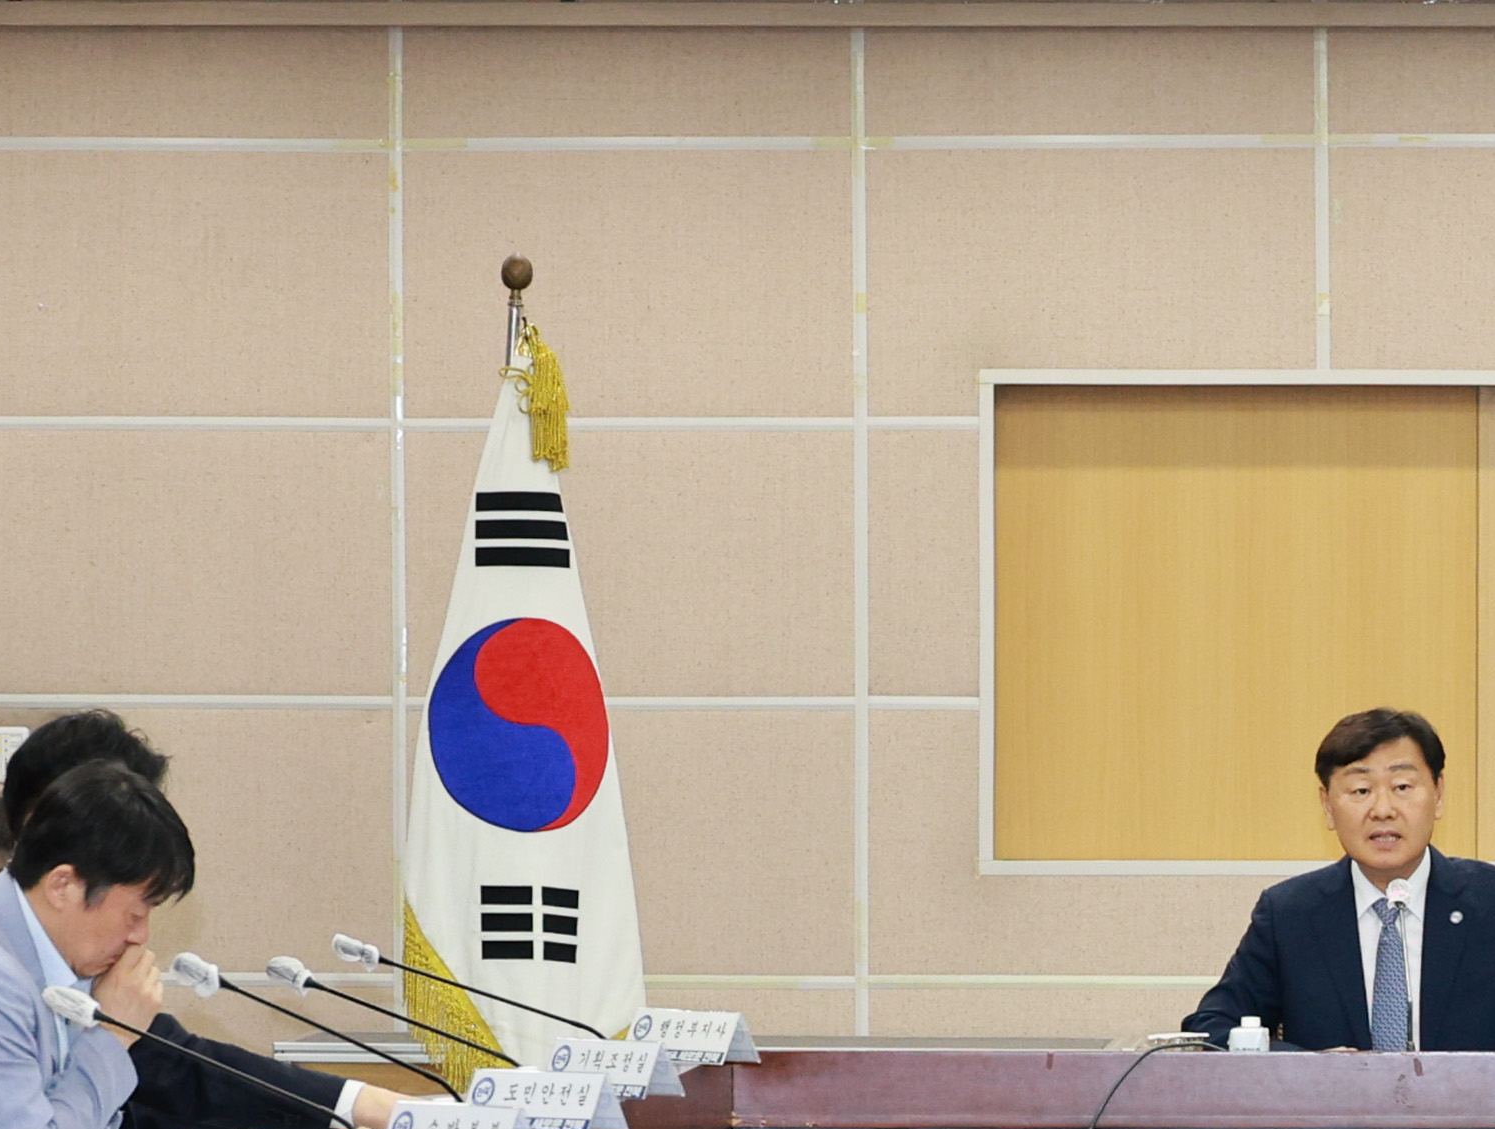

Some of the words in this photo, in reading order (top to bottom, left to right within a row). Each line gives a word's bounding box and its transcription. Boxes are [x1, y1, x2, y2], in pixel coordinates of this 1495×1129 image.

[660, 1018, 727, 1038] 행정부지사
[578, 1049, 649, 1075] 기획조정실
[503, 1082, 591, 1107] 도민안전실
